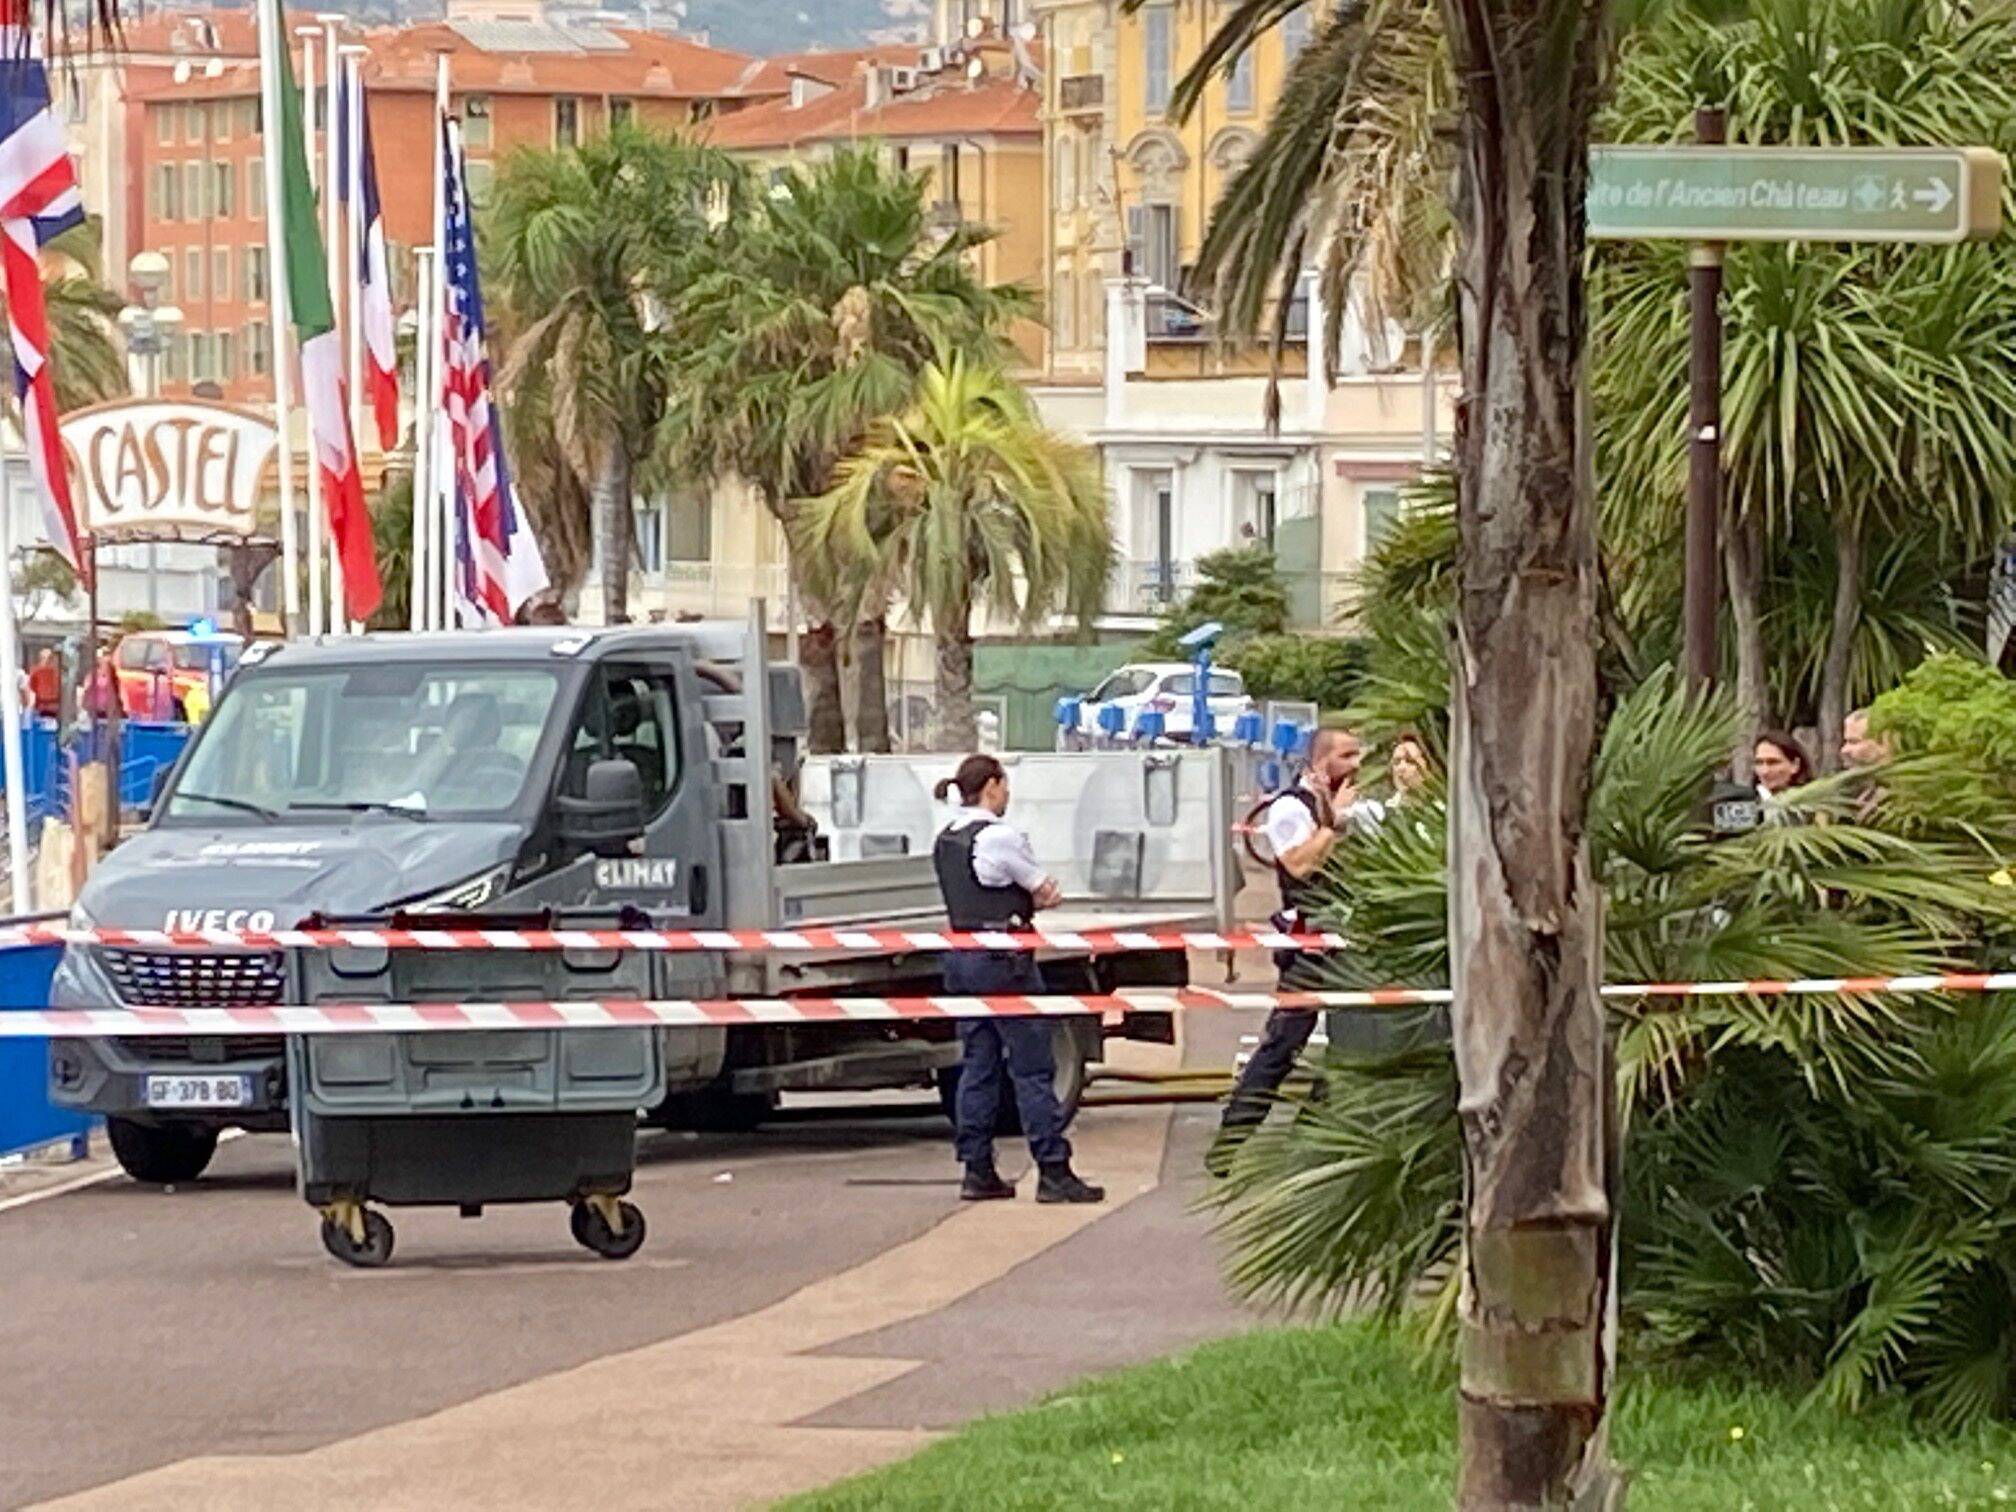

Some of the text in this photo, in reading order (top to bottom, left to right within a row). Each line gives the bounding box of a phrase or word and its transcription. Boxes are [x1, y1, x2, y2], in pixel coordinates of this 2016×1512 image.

[1586, 176, 1848, 208] ite de l'Ancien Château
[90, 418, 250, 514] CASTEL
[595, 859, 676, 887] CLIMAT
[165, 910, 274, 934] IVECO
